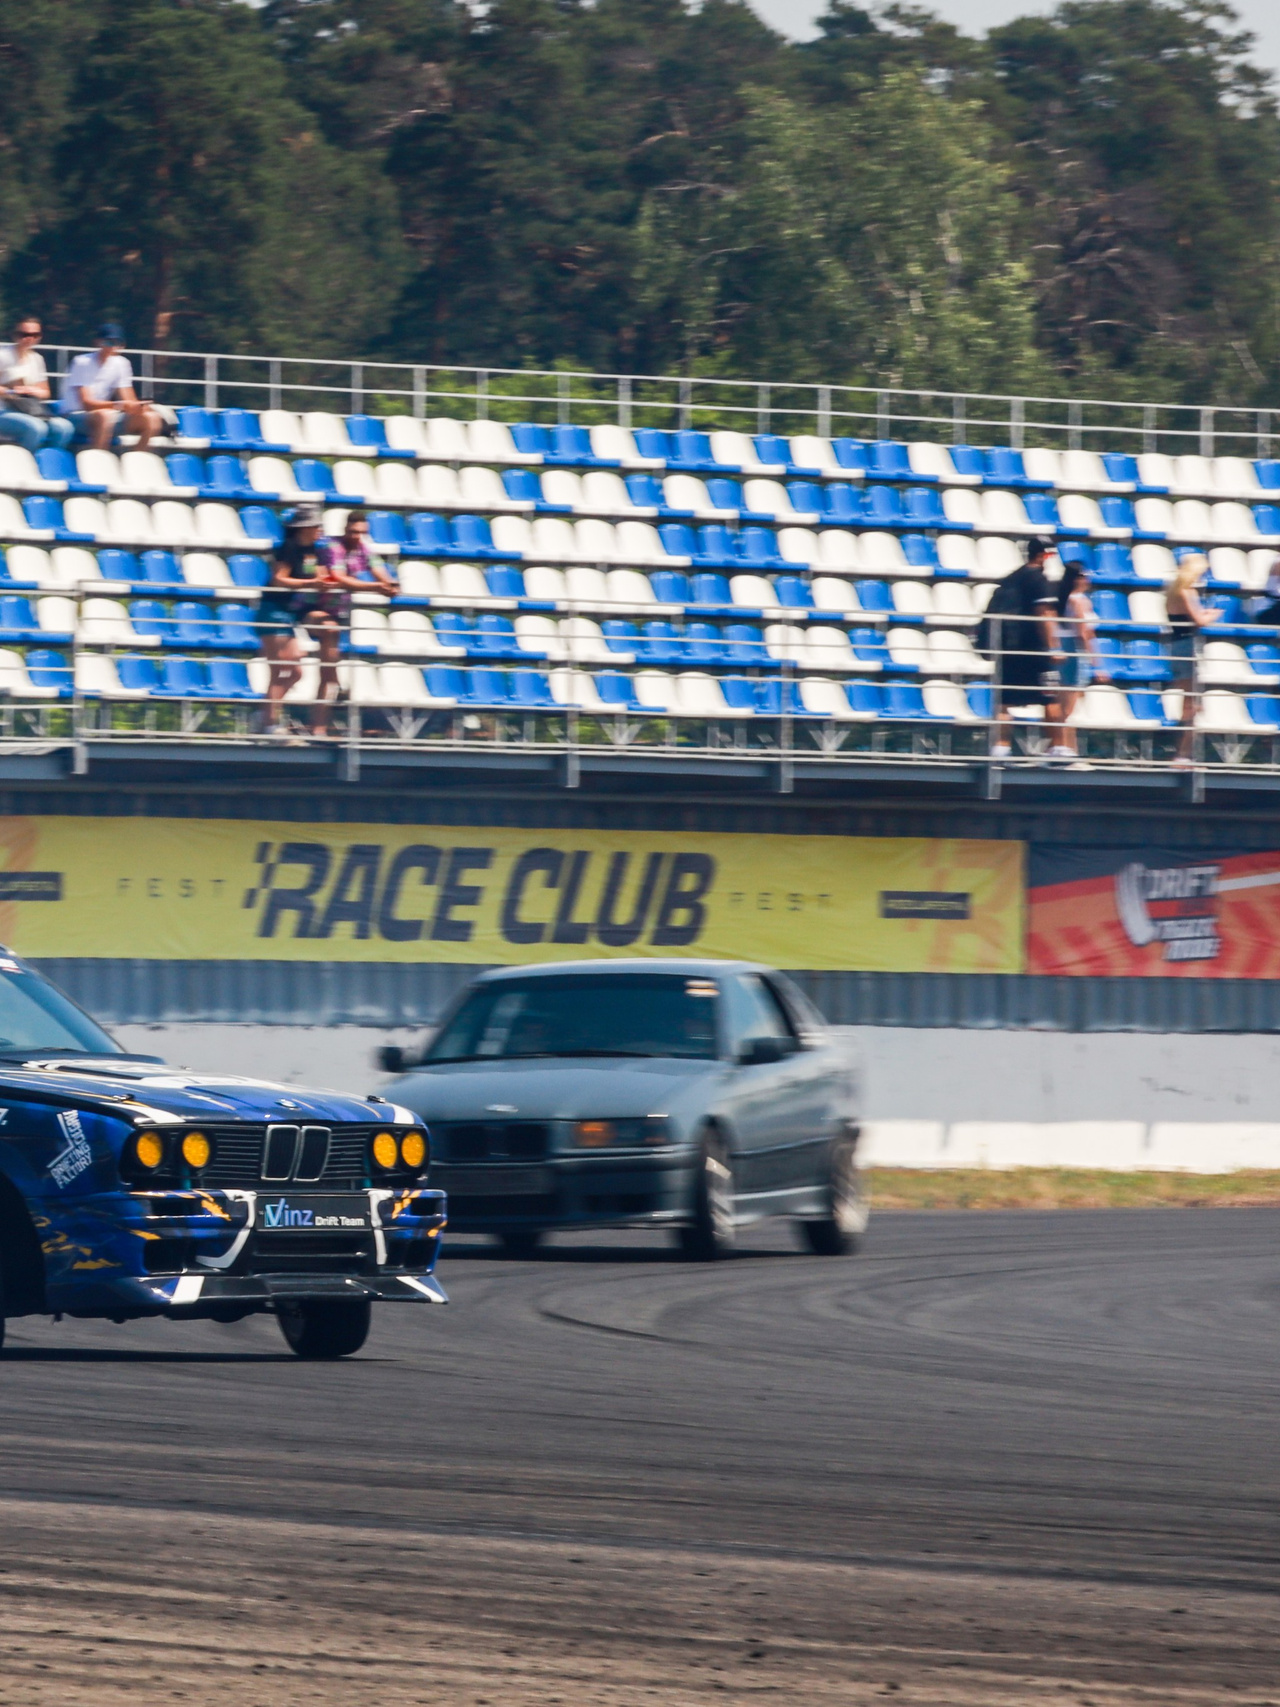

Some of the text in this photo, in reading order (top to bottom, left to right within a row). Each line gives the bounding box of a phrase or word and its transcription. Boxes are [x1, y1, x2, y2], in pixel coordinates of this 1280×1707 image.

[116, 877, 226, 898] FEST
[244, 841, 714, 947] RACE CLUB
[727, 892, 832, 911] FEST
[265, 1198, 366, 1227] Vinz Drift Team
